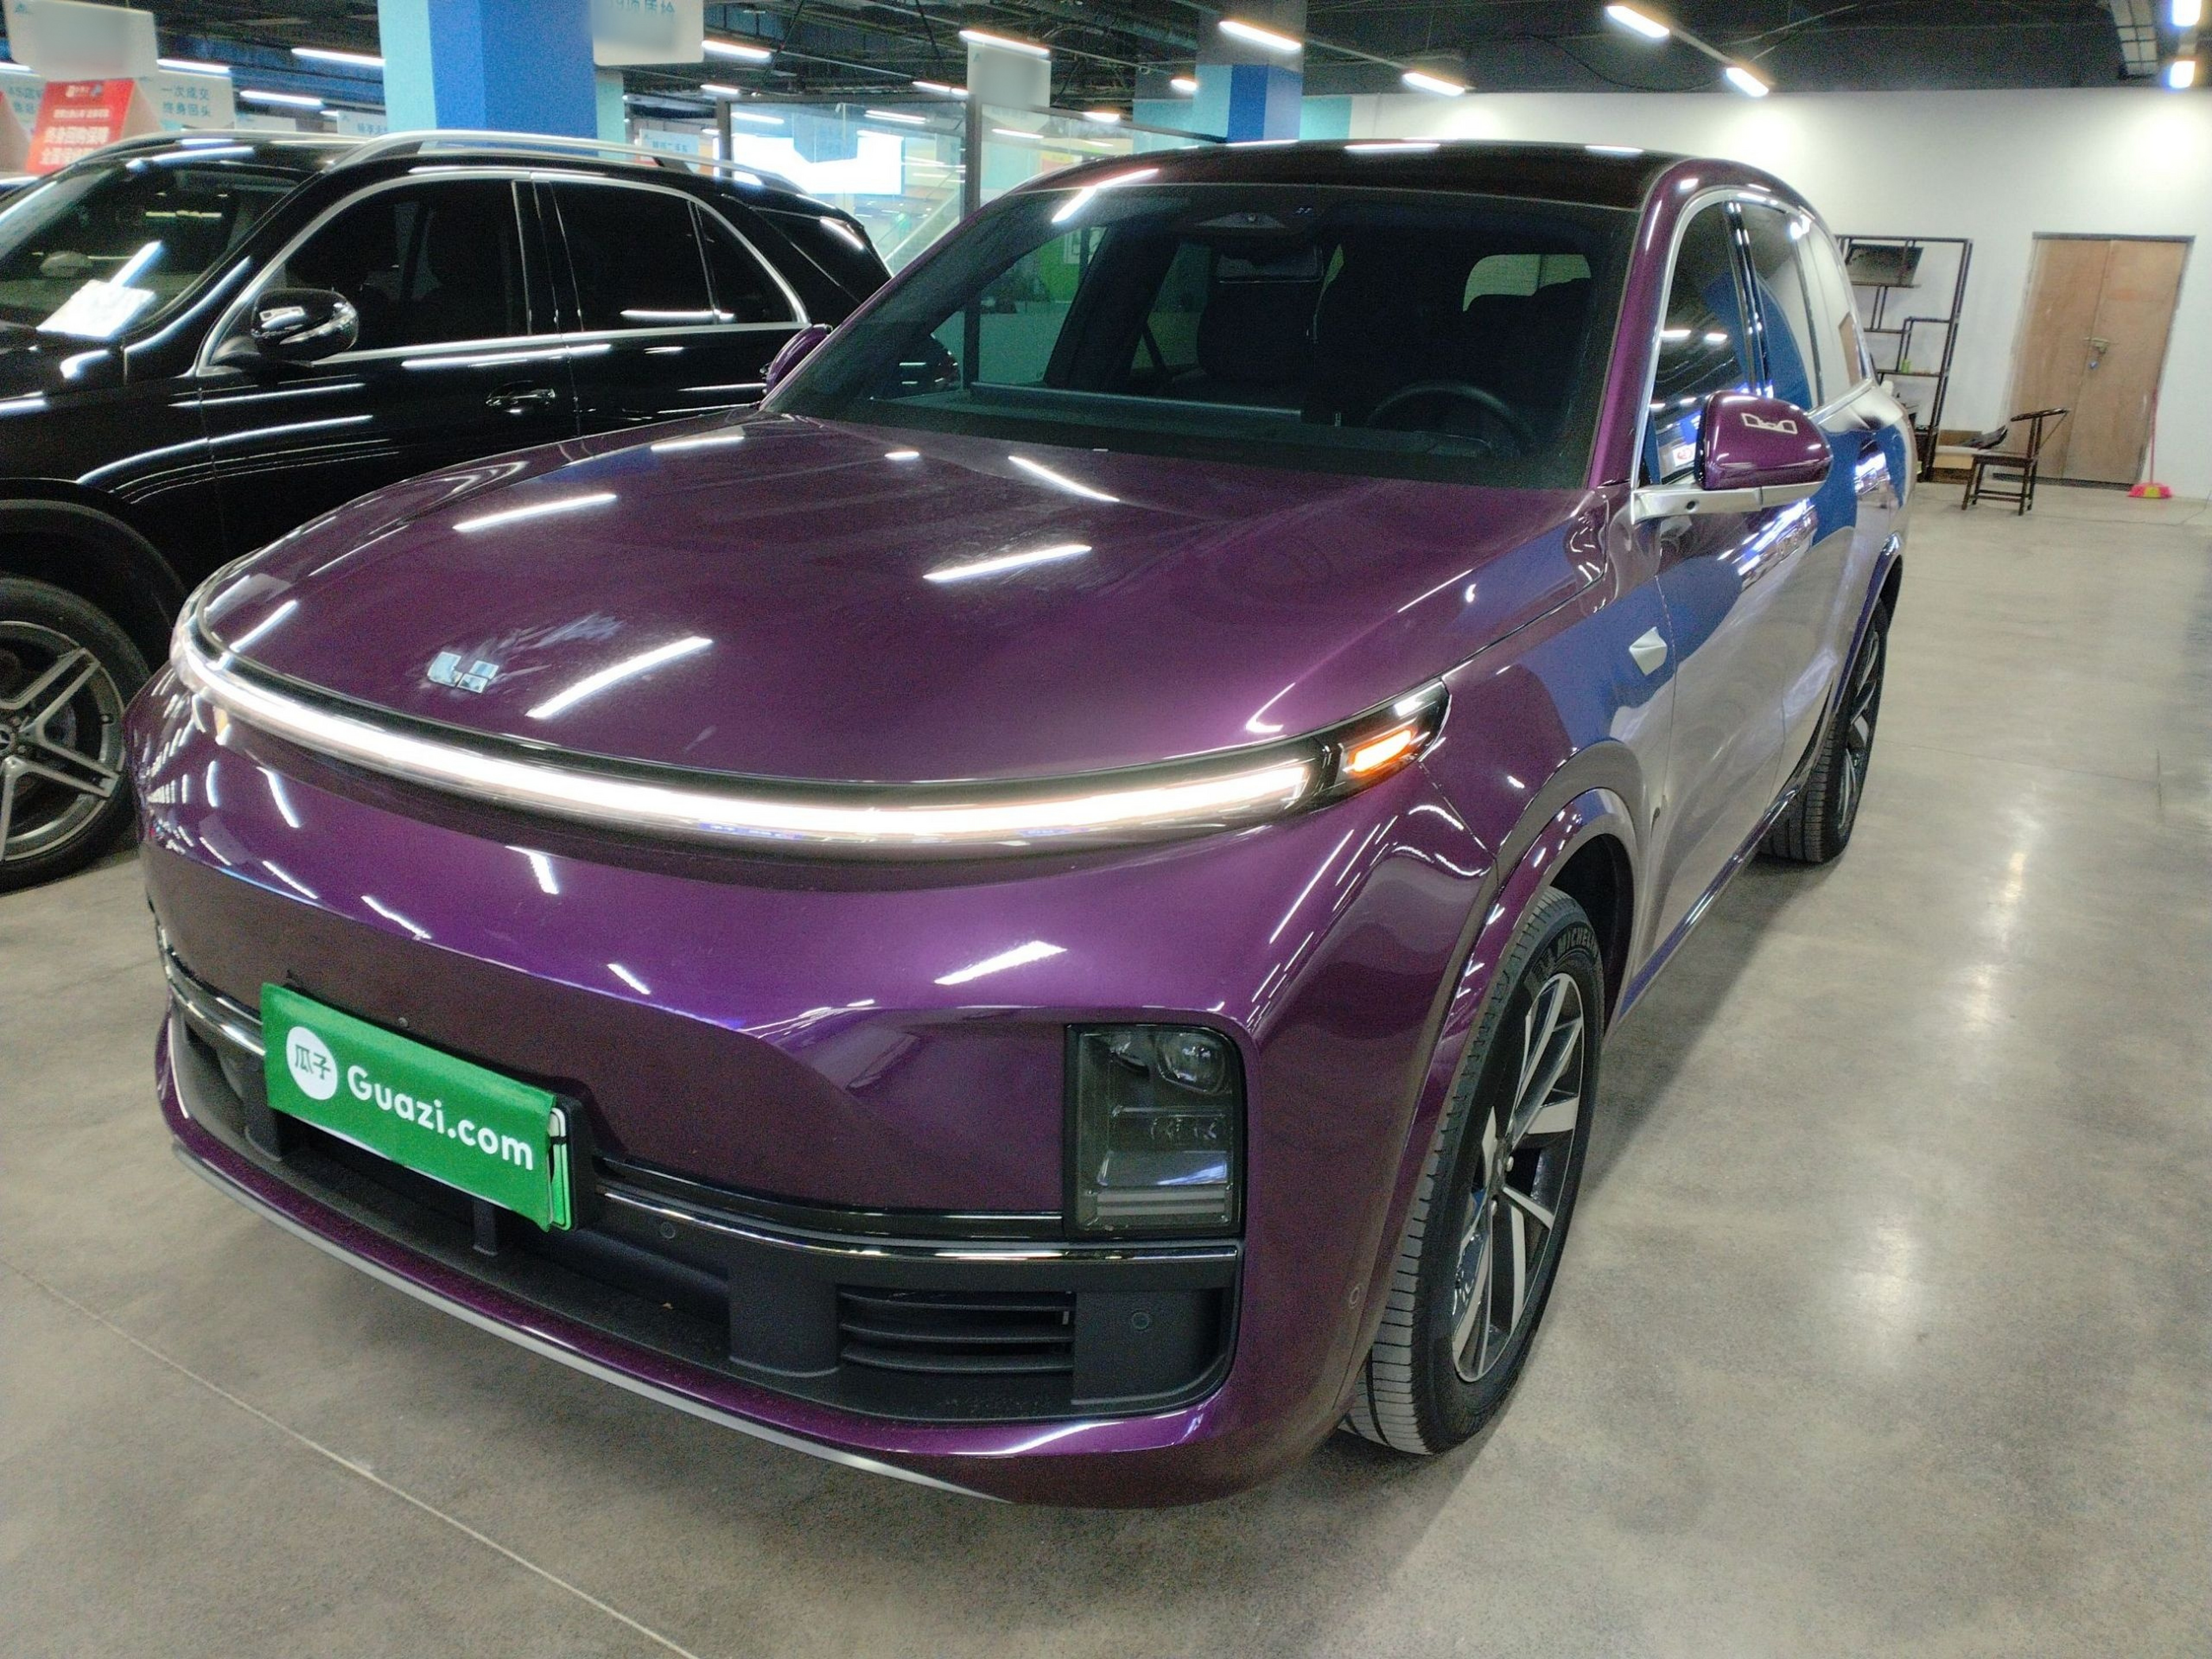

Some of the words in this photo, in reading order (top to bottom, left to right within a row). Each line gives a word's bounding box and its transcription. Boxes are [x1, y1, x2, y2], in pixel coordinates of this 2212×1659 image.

[161, 86, 210, 100] 一次成交
[295, 1044, 331, 1080] 瓜子
[347, 1065, 533, 1171] Guazi.com
